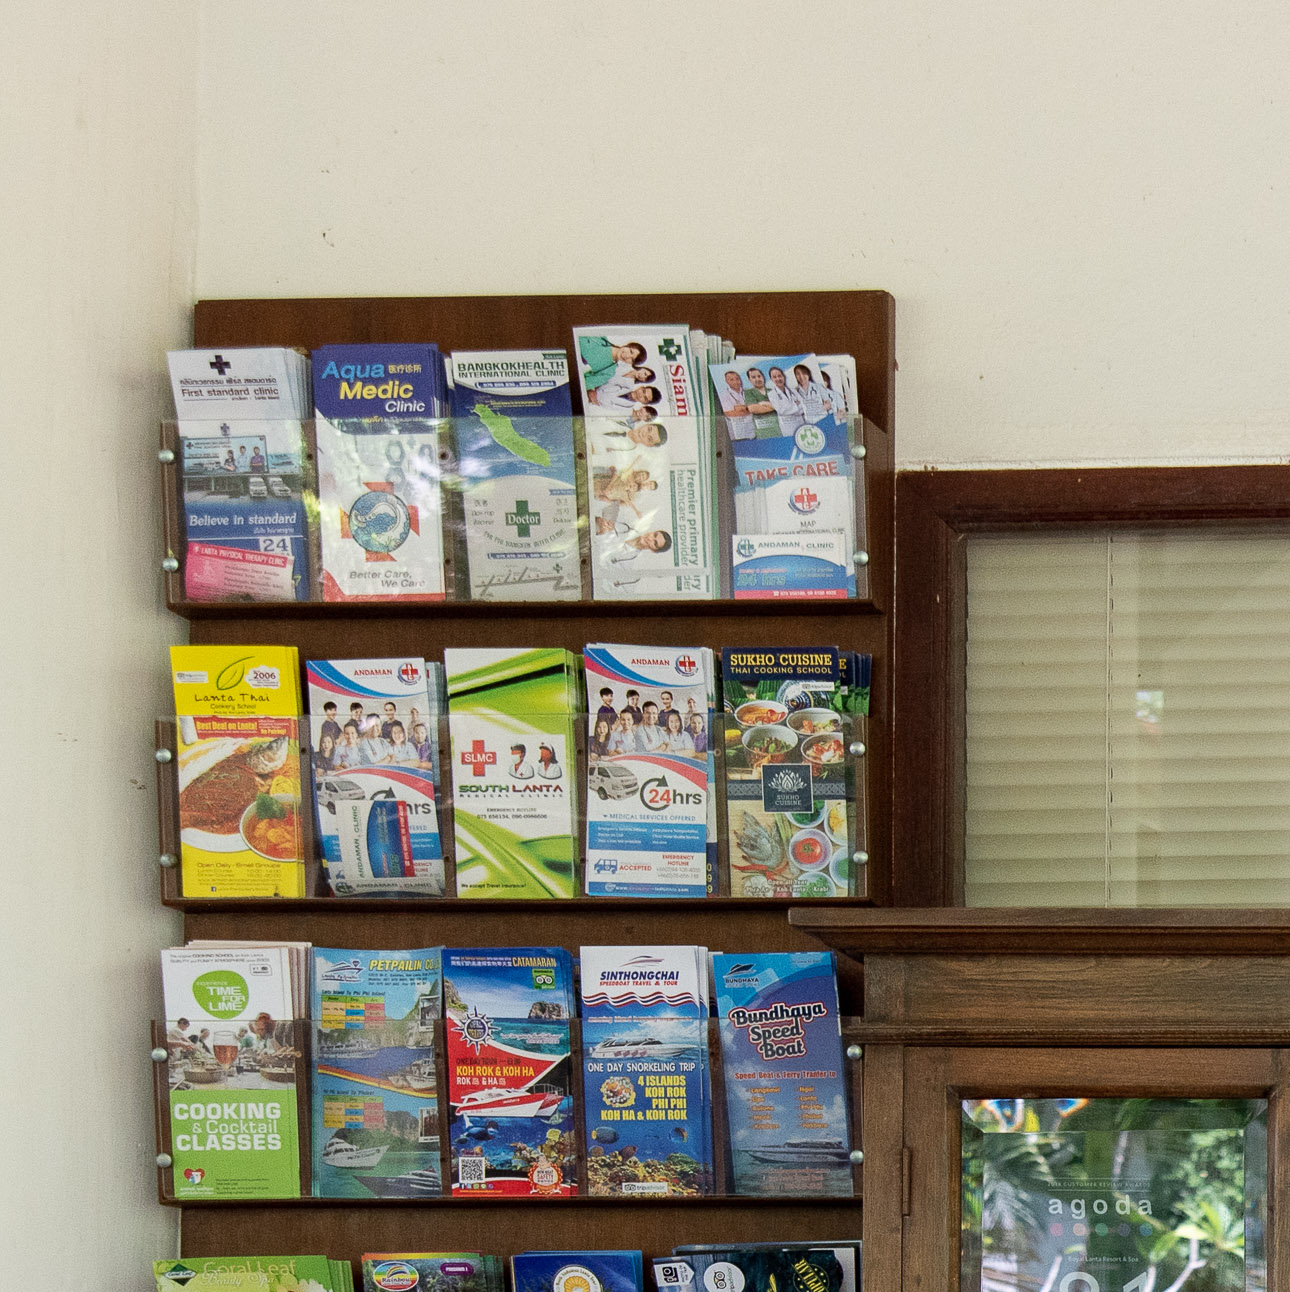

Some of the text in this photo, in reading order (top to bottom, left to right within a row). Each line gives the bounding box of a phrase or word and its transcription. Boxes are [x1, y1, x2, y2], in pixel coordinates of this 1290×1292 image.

[321, 361, 385, 382] Aqua
[457, 361, 565, 371] BANGKOKHEALTH
[457, 370, 565, 379] INTERNATIONAL CLINIC
[181, 387, 279, 397] First standard clinic
[339, 381, 414, 400] Medic
[669, 364, 688, 417] Siam
[385, 400, 425, 412] Clinic
[189, 512, 297, 527] Believe in standard
[507, 514, 540, 525] Doctor
[262, 538, 289, 552] 24
[630, 658, 670, 667] ANDAMAN
[730, 653, 833, 667] SUKHO CUISINE
[353, 668, 393, 677] ANDAMAN
[730, 667, 833, 675] THAI COOKING SCHOOL
[464, 753, 494, 763] SLMC
[458, 784, 563, 793] SOUTH LANTA
[511, 957, 557, 967] CATAMARAN
[600, 970, 680, 981] SINTHONGCHAI
[206, 986, 242, 996] TIME
[209, 1002, 243, 1011] LIME
[731, 1003, 825, 1026] Bundhaya
[749, 1018, 802, 1044] Speed
[759, 1041, 805, 1059] Boat
[456, 1066, 535, 1077] KOH ROK & KOH HA
[587, 1063, 696, 1072] ONE DAY SNORKELING TRIP
[456, 1076, 472, 1086] ROK
[637, 1075, 686, 1086] 4 ISLANDS
[644, 1087, 687, 1098] KOH ROK
[652, 1098, 687, 1109] PHI PHI
[174, 1102, 281, 1121] COOKING
[600, 1109, 687, 1121] KOH HA & KOH ROK
[192, 1120, 278, 1135] & Cocktail
[176, 1134, 282, 1151] CLASSES
[1048, 1194, 1153, 1219] agoda
[1067, 1256, 1084, 1264] Royal
[1127, 1257, 1139, 1265] Spa
